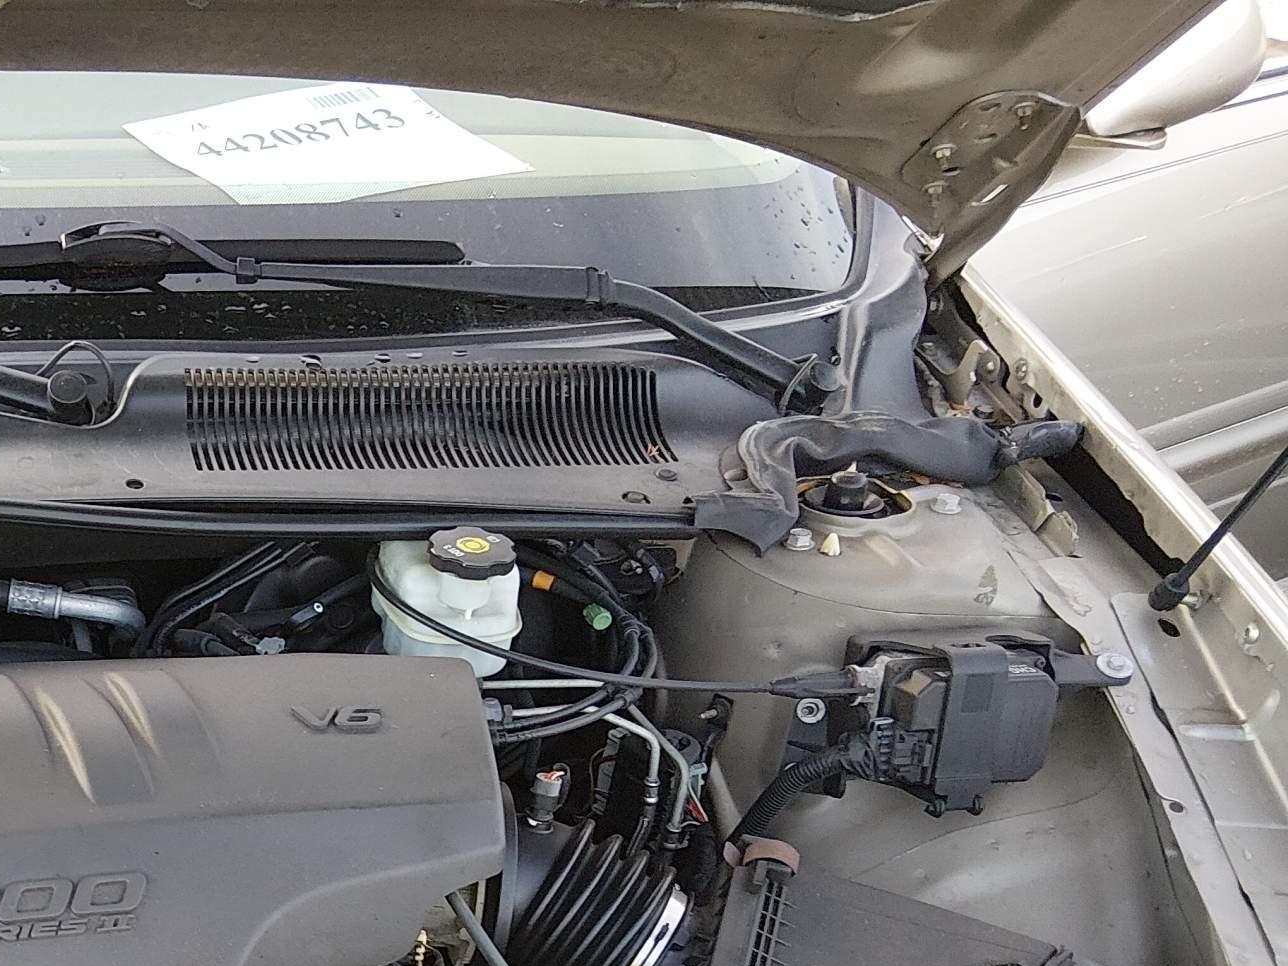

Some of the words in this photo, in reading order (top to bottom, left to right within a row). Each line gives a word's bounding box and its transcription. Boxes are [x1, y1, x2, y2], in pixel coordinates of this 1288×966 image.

[197, 108, 405, 157] 44208743
[291, 706, 381, 732] V6
[96, 914, 137, 933] II
